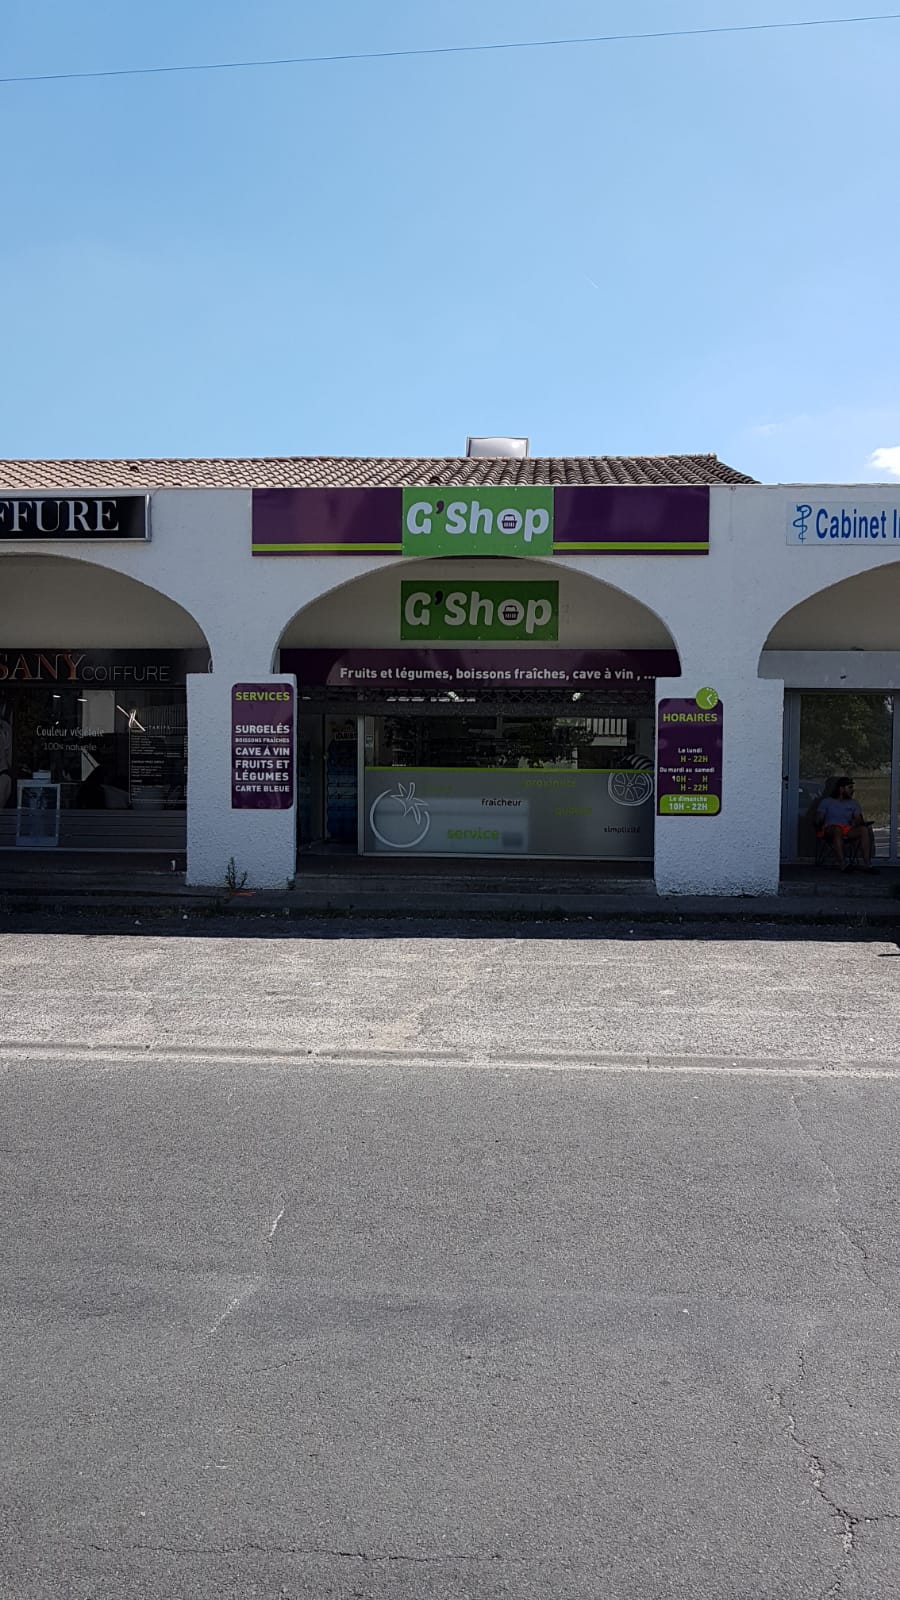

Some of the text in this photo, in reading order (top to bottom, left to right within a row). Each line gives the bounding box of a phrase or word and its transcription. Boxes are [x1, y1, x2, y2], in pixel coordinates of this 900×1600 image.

[816, 508, 886, 538] Cabinet
[82, 665, 170, 681] COIFFURE
[340, 667, 378, 679] Fruits
[380, 668, 393, 679] et
[395, 667, 453, 681] légumes,
[456, 668, 511, 679] boissons
[514, 668, 569, 680] fraîches,
[573, 671, 601, 679] cave
[604, 668, 612, 679] à
[235, 691, 290, 701] SERVICES
[663, 713, 717, 722] HORAIRES
[36, 725, 68, 738] Couleur
[235, 723, 290, 734] SURGELÉS
[235, 747, 262, 756] CAVE
[273, 747, 290, 756] VIN
[235, 760, 290, 769] FRUITS ET
[235, 769, 289, 781] LÉGUMES
[448, 829, 499, 840] service
